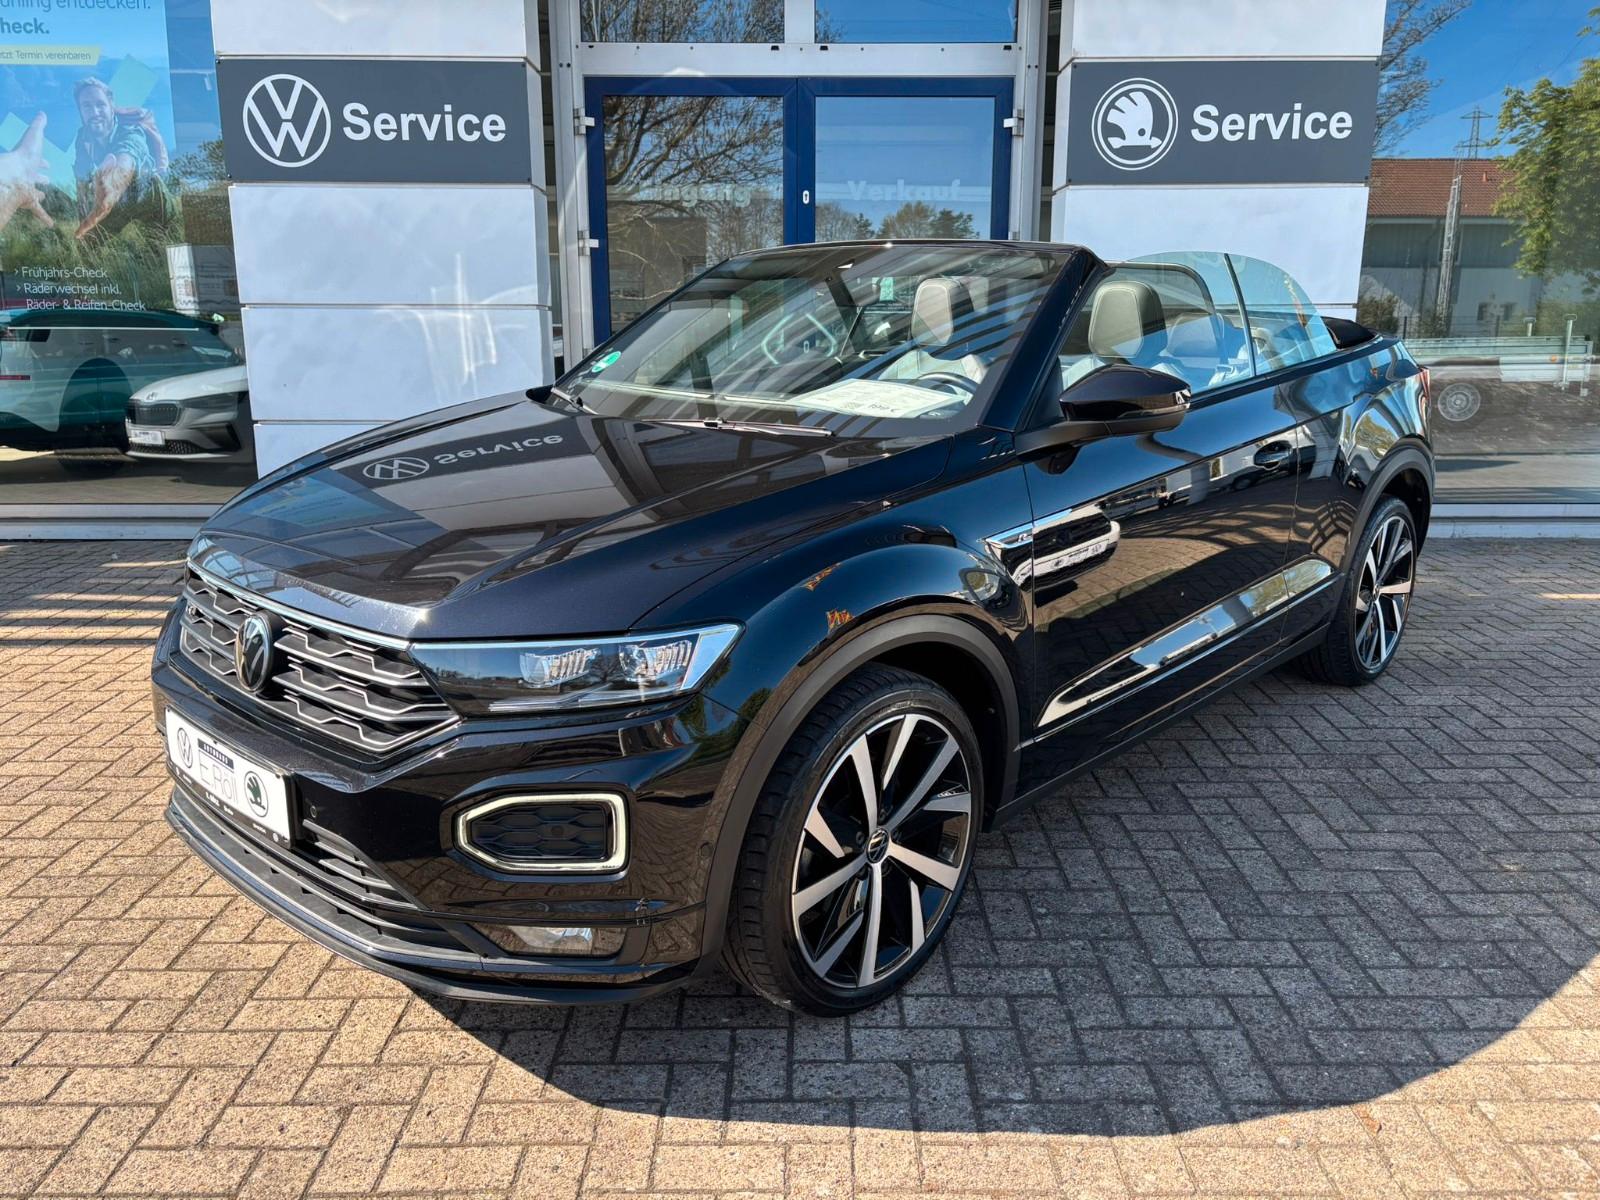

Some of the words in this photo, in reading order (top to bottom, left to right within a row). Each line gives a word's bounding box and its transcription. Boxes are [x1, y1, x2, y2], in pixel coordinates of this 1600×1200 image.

[342, 102, 506, 142] Service
[1191, 103, 1353, 142] Service
[848, 179, 961, 201] Verkauf
[21, 266, 108, 280] Frühjahrs-Check
[23, 283, 98, 295] Räderwechsel
